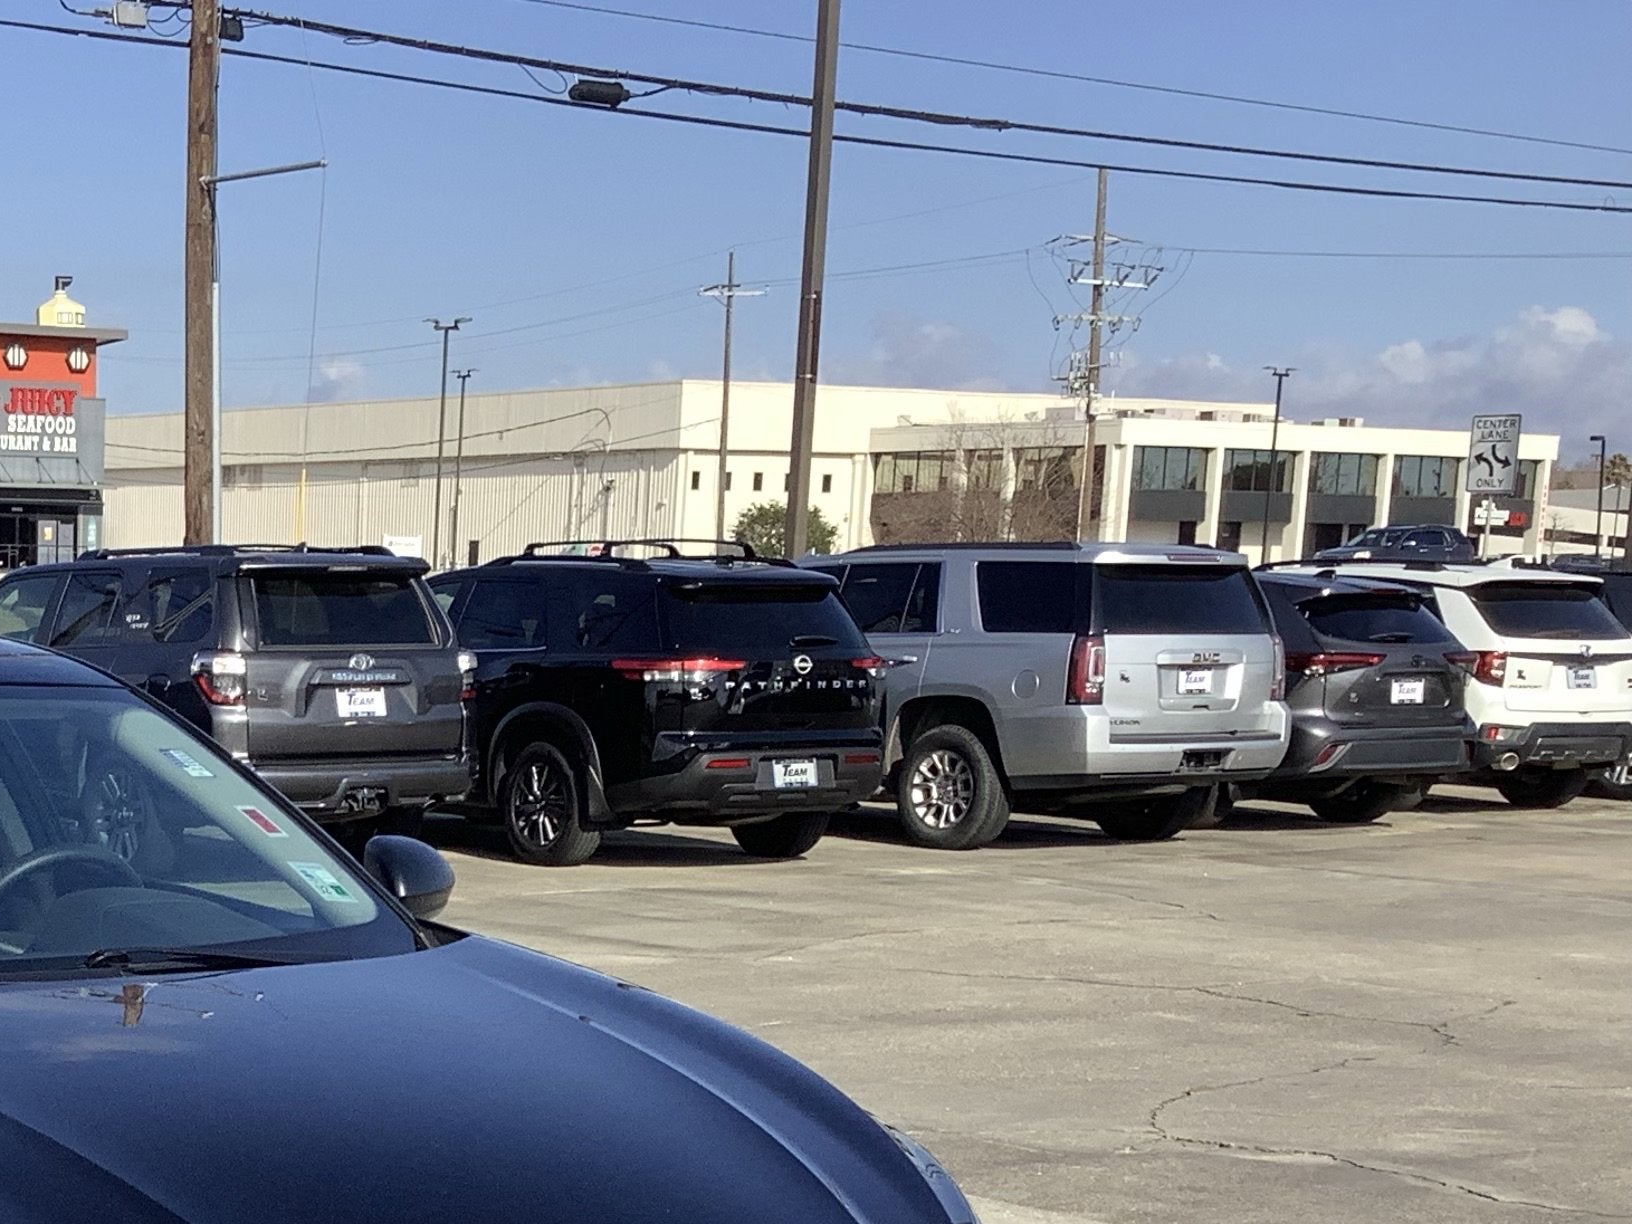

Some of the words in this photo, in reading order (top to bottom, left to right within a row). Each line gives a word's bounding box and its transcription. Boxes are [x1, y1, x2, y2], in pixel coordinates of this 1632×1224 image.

[4, 386, 78, 416] JUICY
[8, 415, 76, 435] SEAFOOD
[1476, 419, 1517, 430] CENTER
[1481, 429, 1509, 440] LANE
[42, 435, 51, 452] &
[53, 436, 77, 453] BAR
[1476, 478, 1504, 488] ONLY
[725, 679, 867, 692] PATHFINDER
[347, 692, 375, 706] TEAM
[781, 764, 808, 777] TEAM
